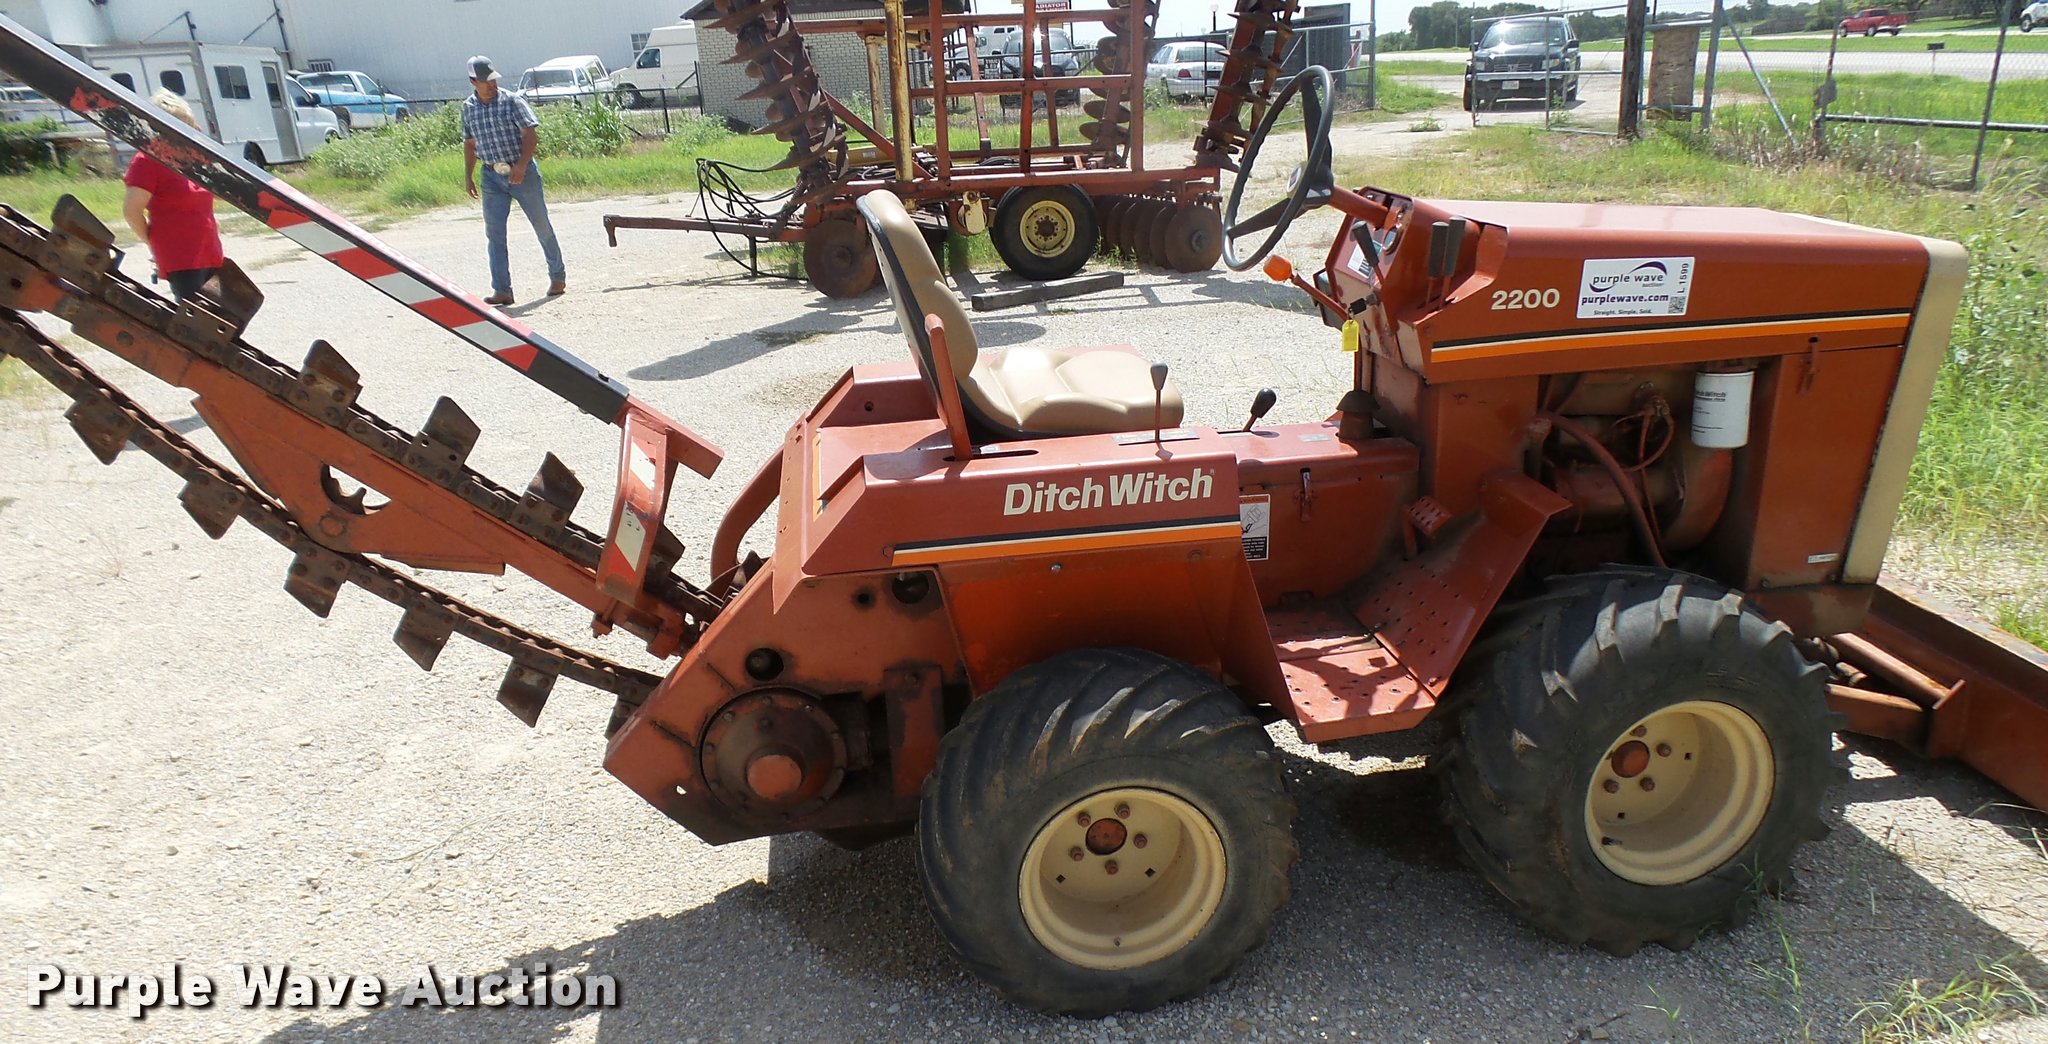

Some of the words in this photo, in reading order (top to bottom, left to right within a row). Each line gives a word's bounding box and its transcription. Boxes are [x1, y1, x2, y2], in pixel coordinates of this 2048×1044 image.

[1593, 274, 1630, 285] purple
[1634, 274, 1664, 282] wave
[1680, 263, 1689, 285] 1599
[1491, 288, 1560, 310] 2200
[1581, 294, 1669, 306] purplewave.com
[1004, 477, 1104, 516] Ditch
[1109, 468, 1213, 506] Witch
